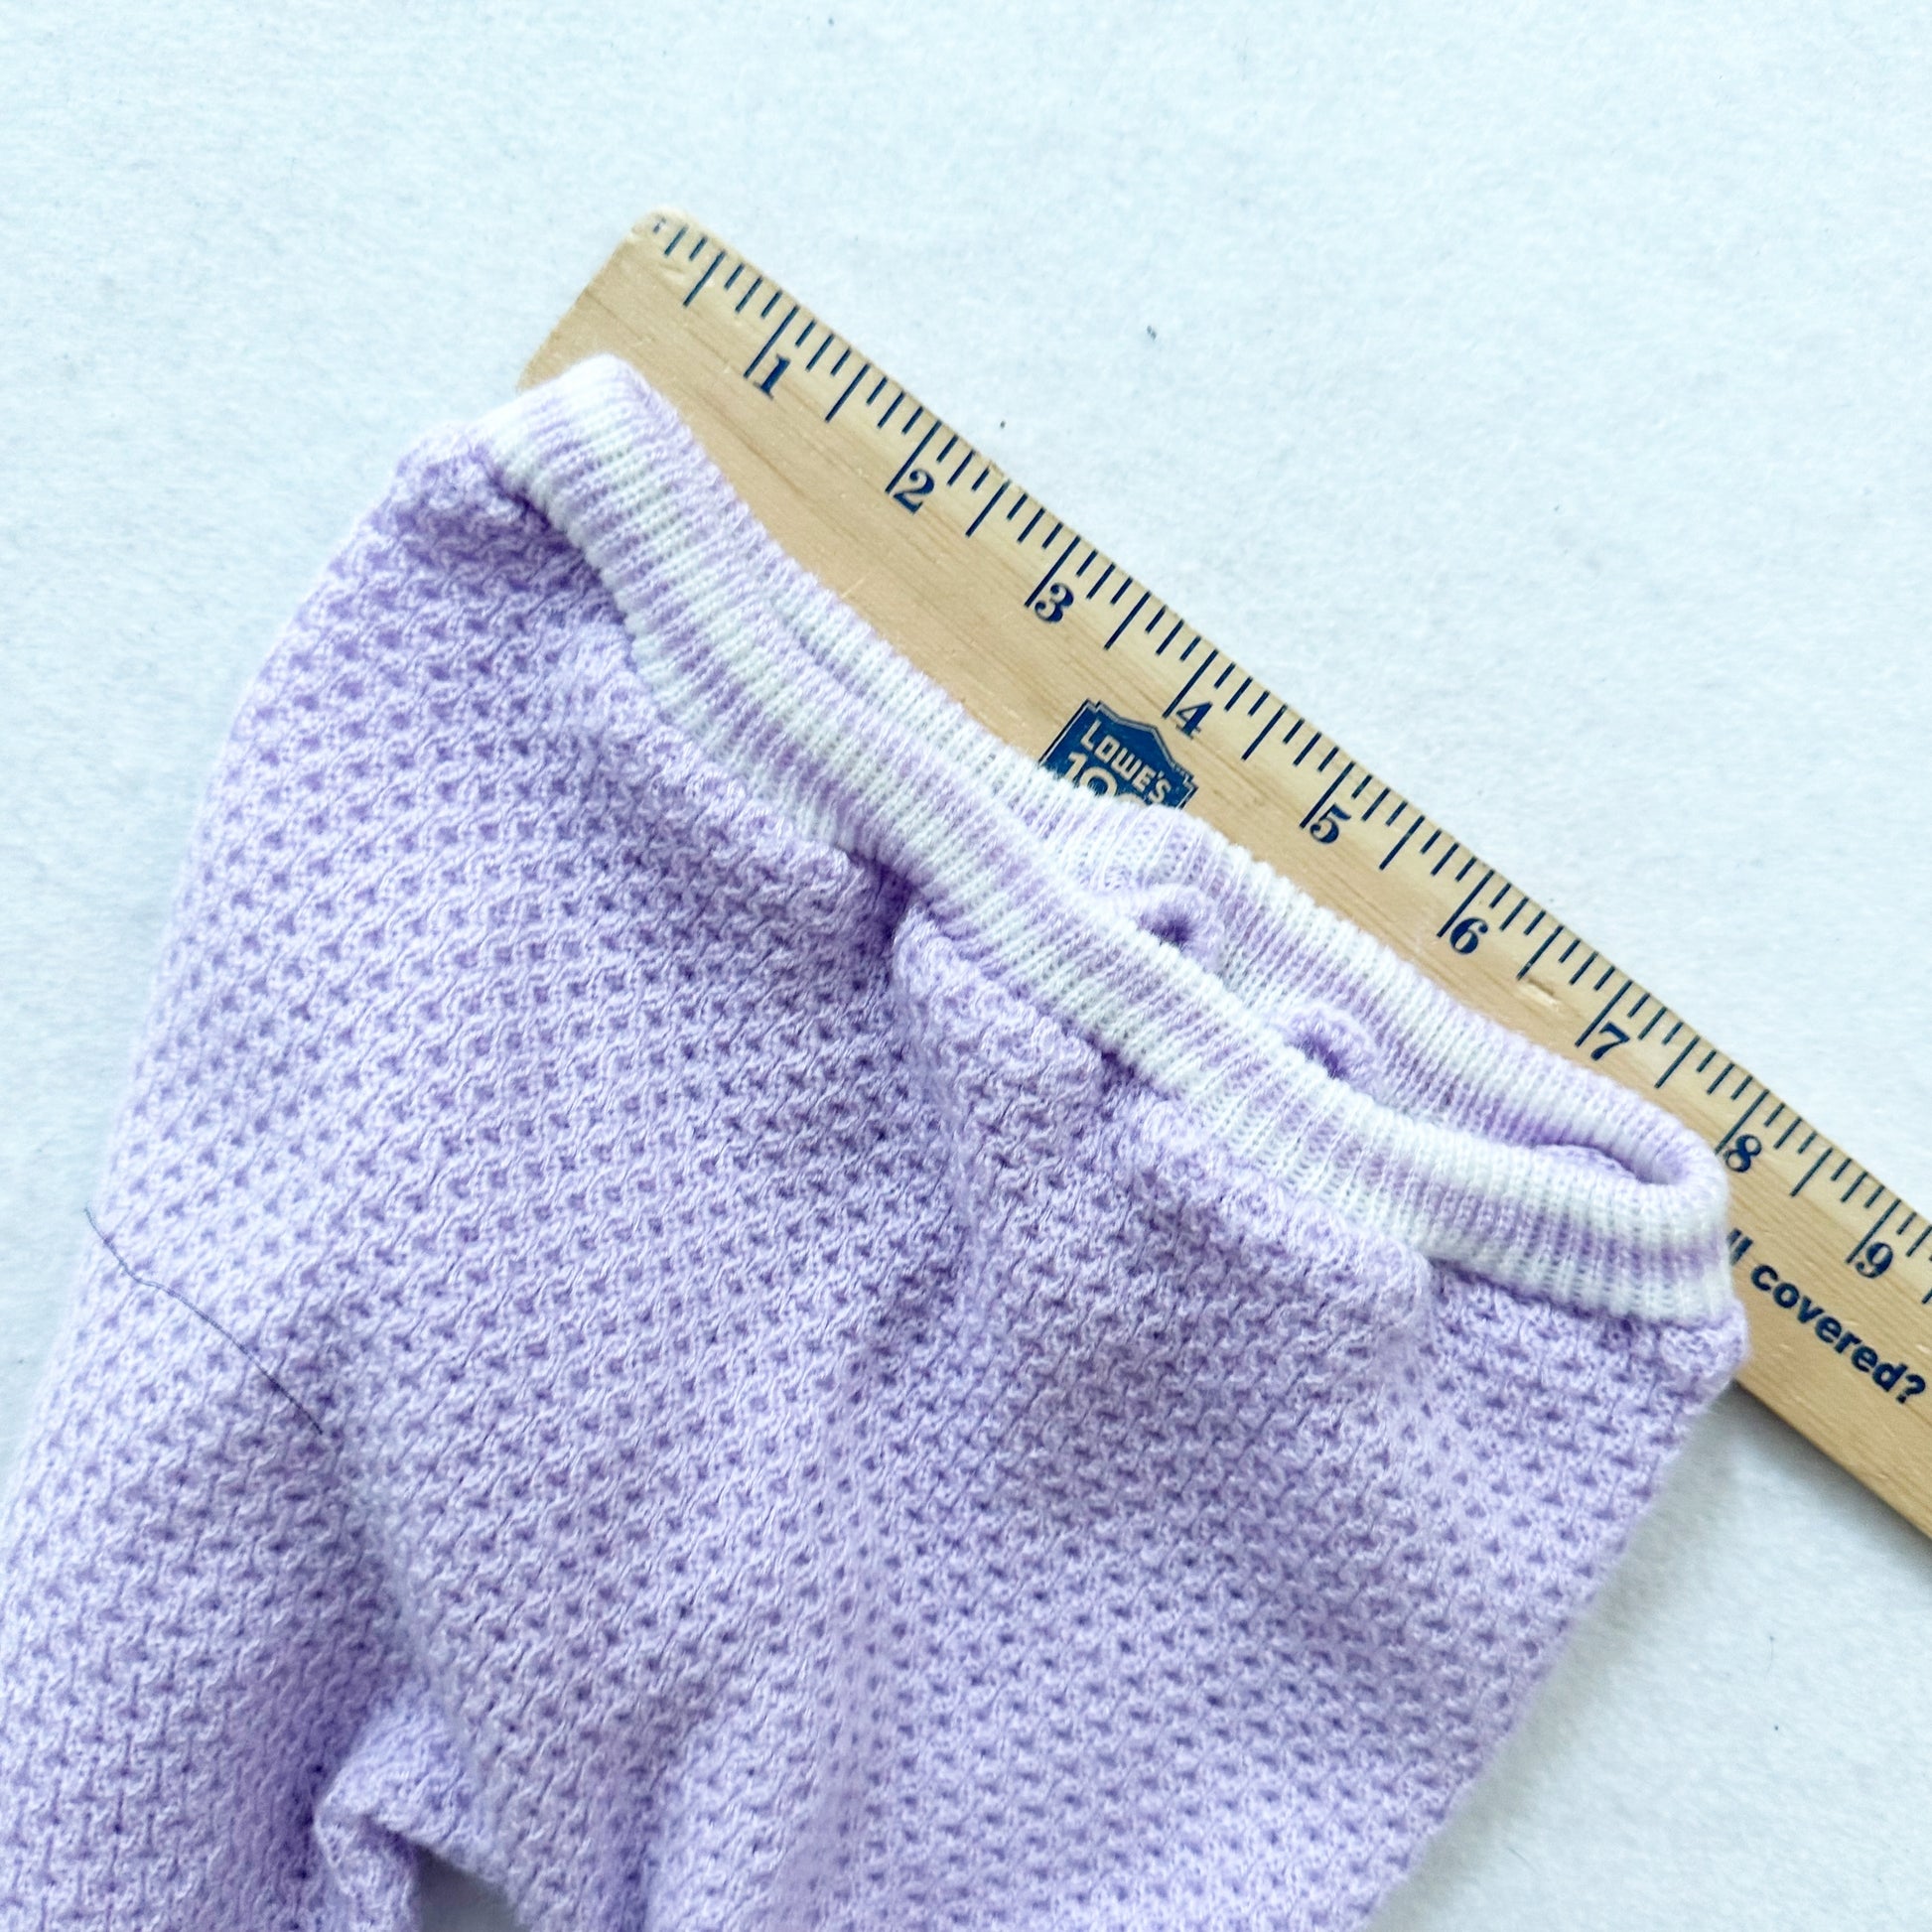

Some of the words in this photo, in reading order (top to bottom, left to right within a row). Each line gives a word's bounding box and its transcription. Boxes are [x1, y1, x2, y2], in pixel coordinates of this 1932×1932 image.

[753, 354, 790, 400] 1
[893, 469, 935, 515] 2
[1034, 582, 1074, 623] 3
[1175, 700, 1213, 740] 4
[1310, 803, 1351, 845] 5
[1449, 916, 1489, 955] 6
[1590, 1022, 1630, 1061] 7
[1723, 1134, 1763, 1173] 8
[1855, 1242, 1894, 1279] 9
[1080, 717, 1172, 804] LOWE'S
[1750, 1263, 1927, 1405] covered?
